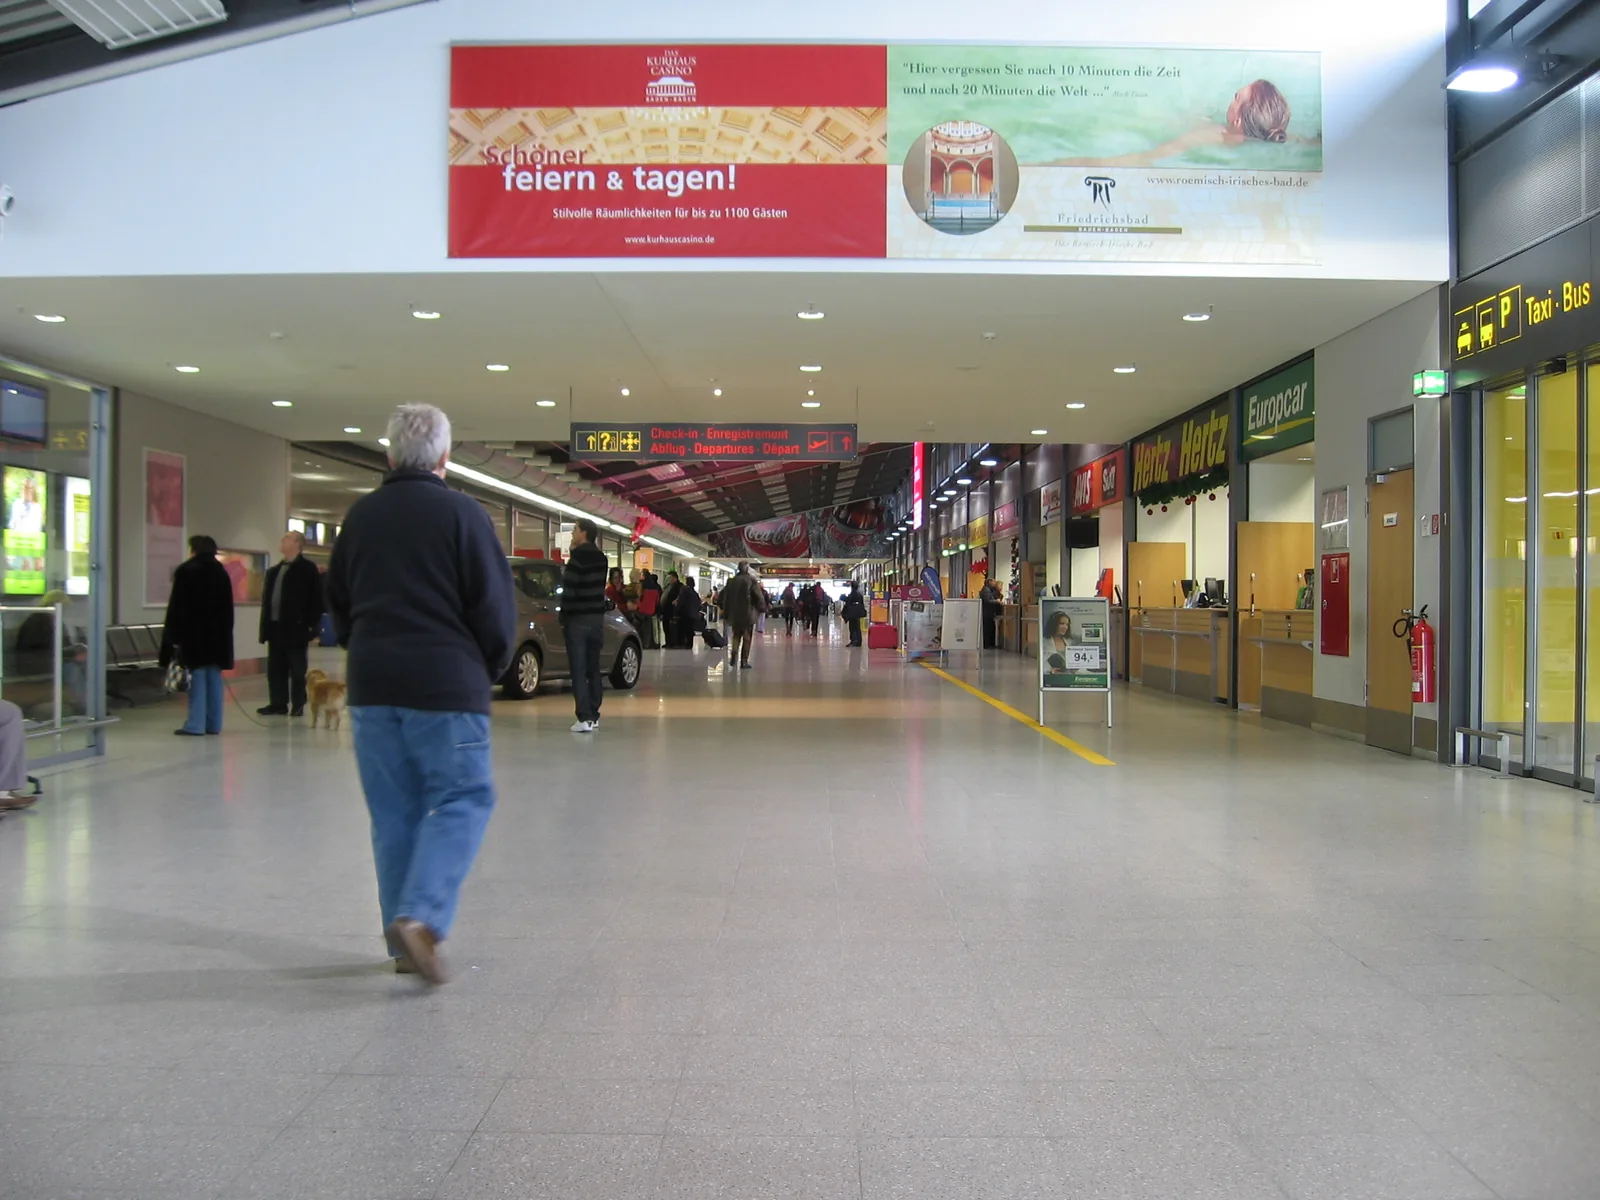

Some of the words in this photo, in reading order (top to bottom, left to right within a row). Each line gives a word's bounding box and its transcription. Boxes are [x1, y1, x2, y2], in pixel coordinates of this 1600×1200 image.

[646, 56, 697, 66] KURHAUS
[650, 66, 692, 75] CASINO
[942, 65, 1001, 76] vergessen
[1005, 63, 1024, 75] Sie
[1027, 64, 1056, 75] nach
[1061, 65, 1075, 76] 10
[1079, 65, 1131, 77] Minuten
[1134, 66, 1153, 77] die
[1156, 66, 1181, 78] Zeit
[903, 83, 926, 95] und
[930, 83, 959, 95] nach
[963, 84, 978, 95] 20
[981, 84, 1034, 96] Minuten
[1037, 85, 1056, 96] die
[1060, 85, 1088, 97] Welt
[483, 143, 588, 165] Schöner
[502, 164, 596, 191] feiern
[606, 171, 624, 190] &
[633, 164, 737, 198] tagen!
[1147, 175, 1309, 188] www.roemisch-irisches-bad.de
[552, 207, 593, 219] Stilvolle
[596, 207, 672, 219] Räumlichkeiten
[675, 207, 689, 219] für
[692, 207, 707, 219] bis
[709, 209, 721, 219] zu
[725, 207, 750, 219] 1100
[752, 207, 788, 219] Gästen
[1058, 214, 1149, 224] Friedrichsbad
[624, 234, 715, 245] www.kurhauscasino.de
[1525, 289, 1552, 326] Taxi
[1563, 281, 1591, 312] Bus
[1247, 381, 1308, 434] Europcar
[650, 427, 698, 439] Check-in
[650, 442, 685, 456] Abflug
[694, 443, 754, 456] Departures
[763, 442, 800, 456] Départ
[1179, 408, 1230, 477] Hertz
[1133, 434, 1172, 493] Hertz
[1073, 469, 1091, 508] AVIS
